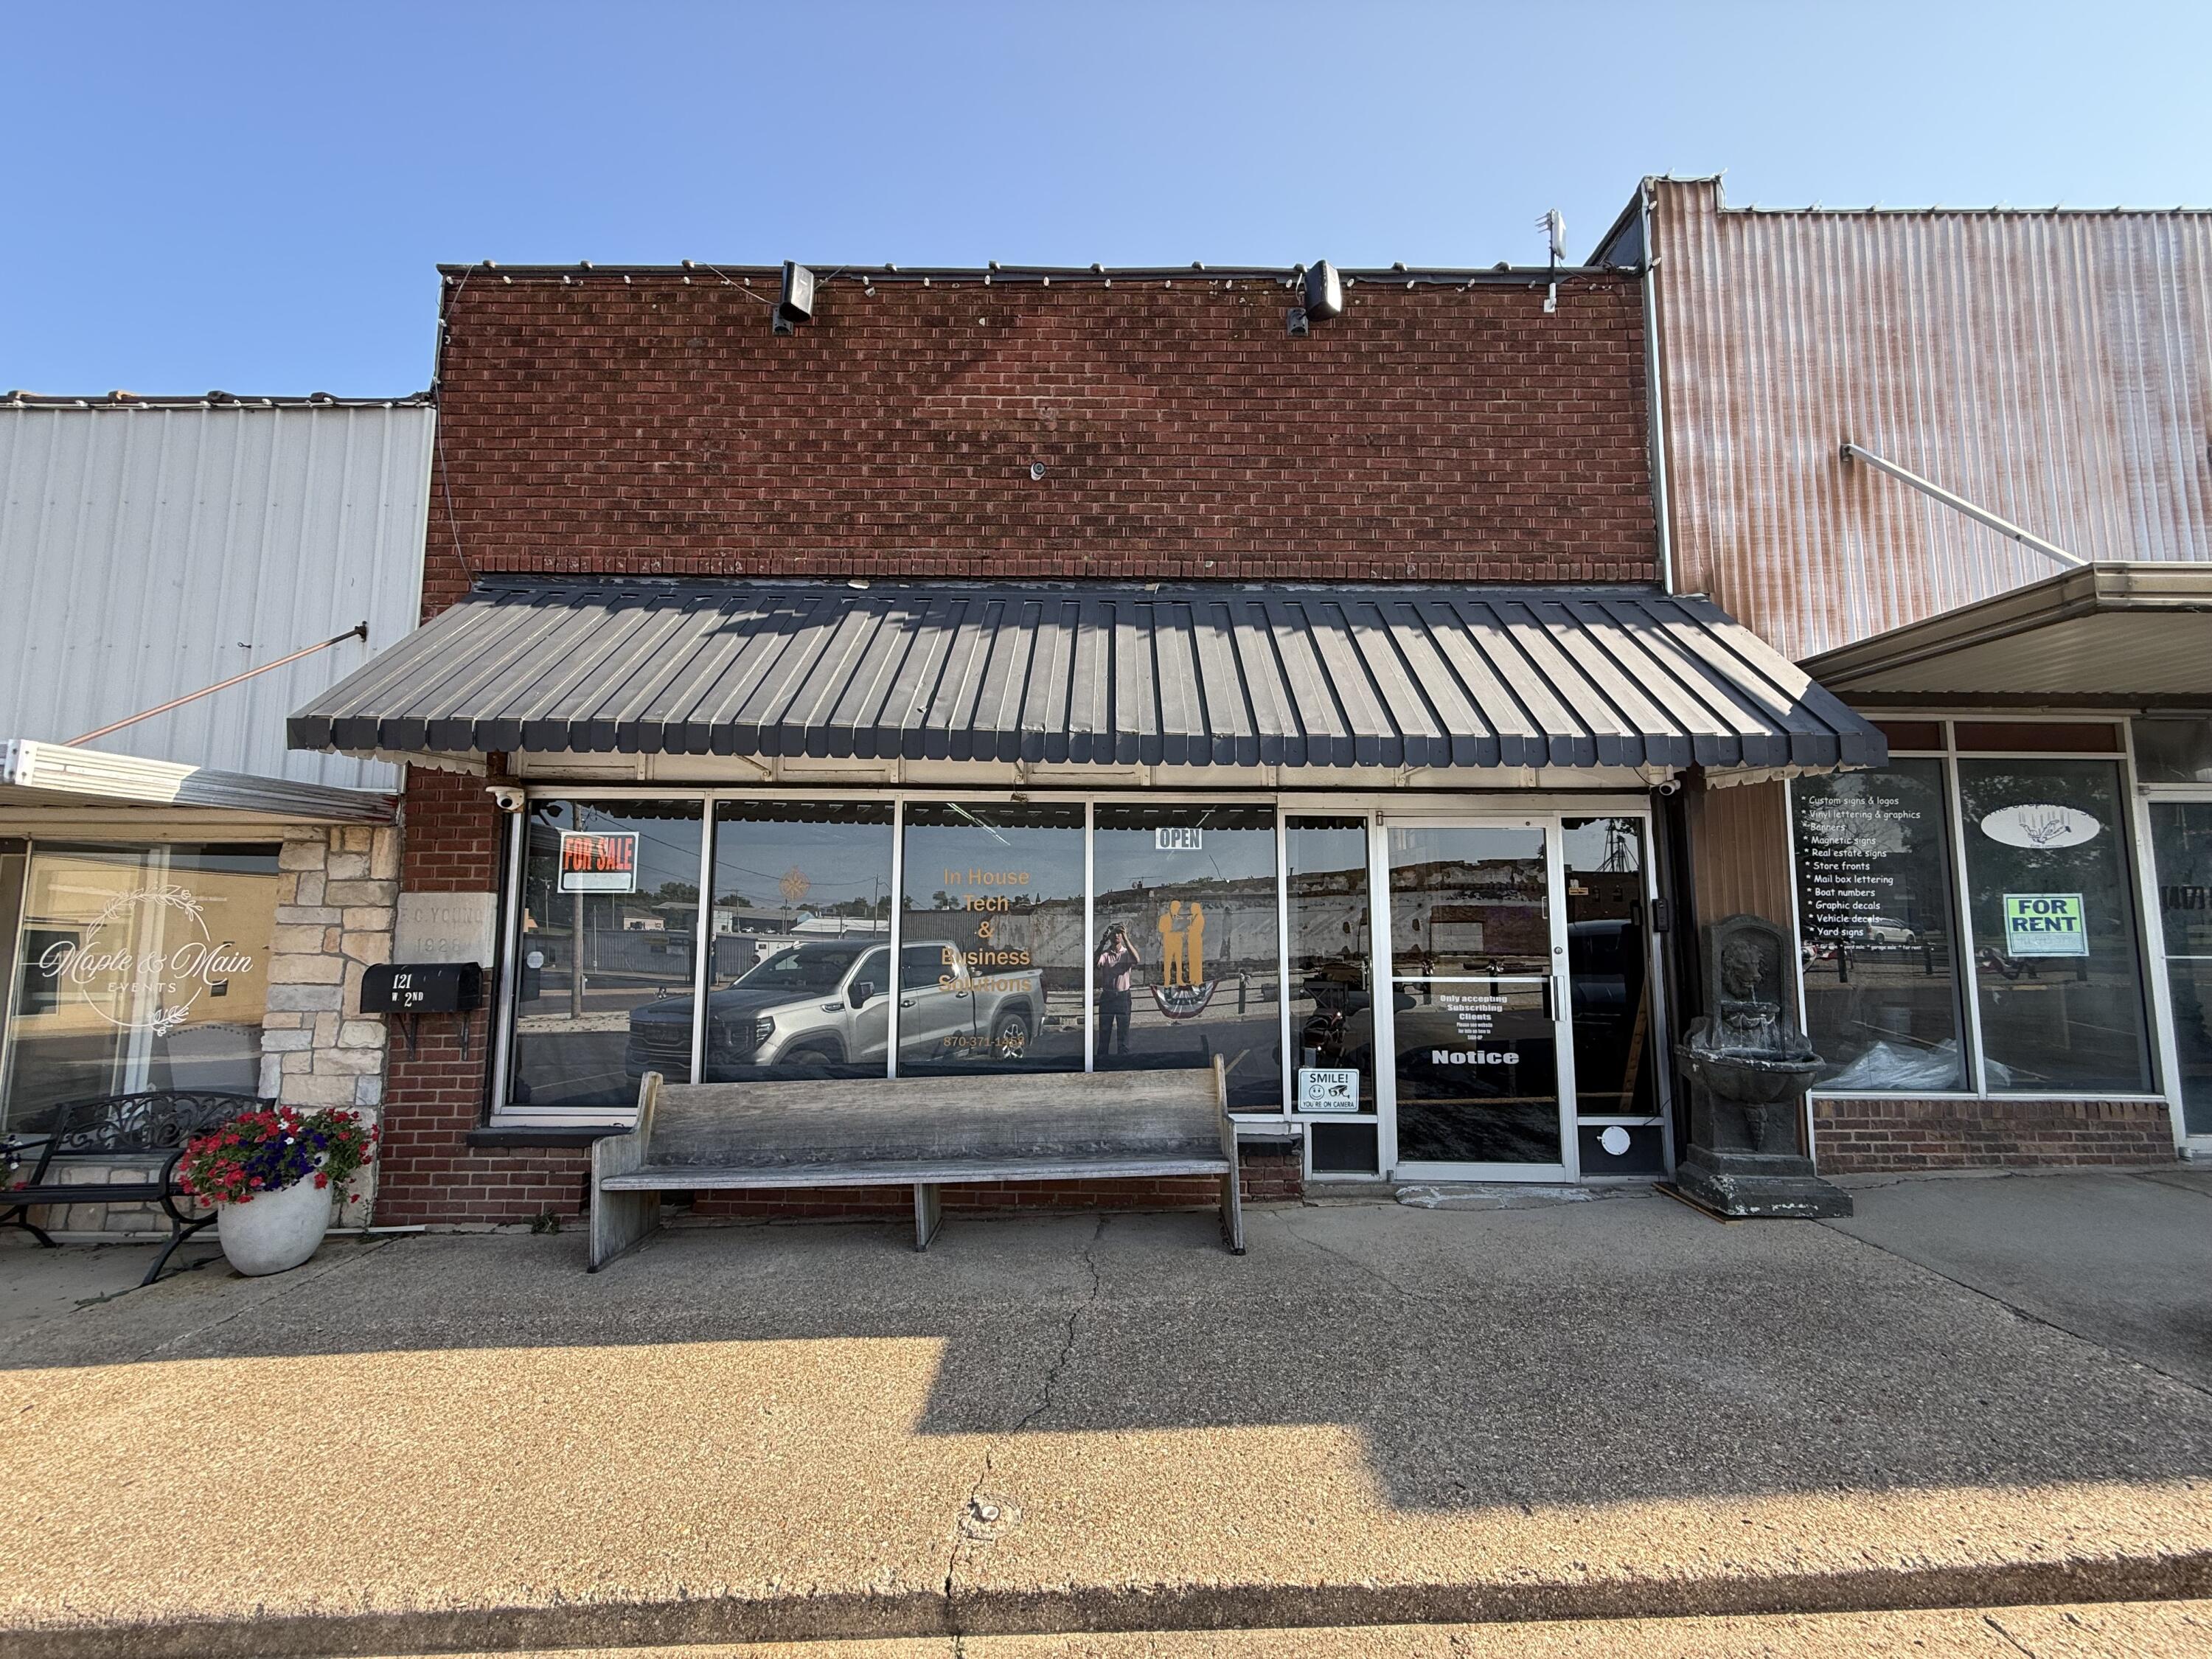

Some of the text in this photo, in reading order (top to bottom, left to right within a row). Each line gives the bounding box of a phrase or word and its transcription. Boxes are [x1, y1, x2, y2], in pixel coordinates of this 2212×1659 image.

[1809, 796, 1899, 807] Custom signs & logos
[1809, 810, 1921, 821] Vinyl lettering & graphics
[1810, 823, 1846, 831] Banners
[1160, 829, 1200, 848] OPEN
[1811, 836, 1876, 846] Magnetic signs
[564, 837, 633, 871] FOR SALE
[1812, 849, 1831, 857] Real
[1865, 850, 1887, 859] signs
[1813, 861, 1870, 870] Store fronts
[943, 867, 1030, 885] In House
[1814, 874, 1893, 886] Mail box lettering
[1815, 888, 1875, 897] Boat numbers
[964, 894, 1009, 911] Tech
[1815, 900, 1880, 911] Graphic decals
[2018, 899, 2067, 914] FOR
[1816, 914, 1879, 922] Vehicle decals
[978, 921, 994, 938] &
[2011, 917, 2077, 931] RENT
[1817, 928, 1864, 937] Yard signs
[941, 947, 1031, 965] Business
[38, 940, 254, 986] Maple & Main
[108, 982, 177, 992] EVENTS
[392, 974, 412, 989] 121
[939, 974, 1032, 992] Solutions
[404, 992, 424, 1007] 2ND
[1440, 995, 1460, 1003] Only
[1447, 1004, 1503, 1012] Subscribing
[1432, 1050, 1520, 1064] Notice
[1310, 1074, 1348, 1083] SMILE!
